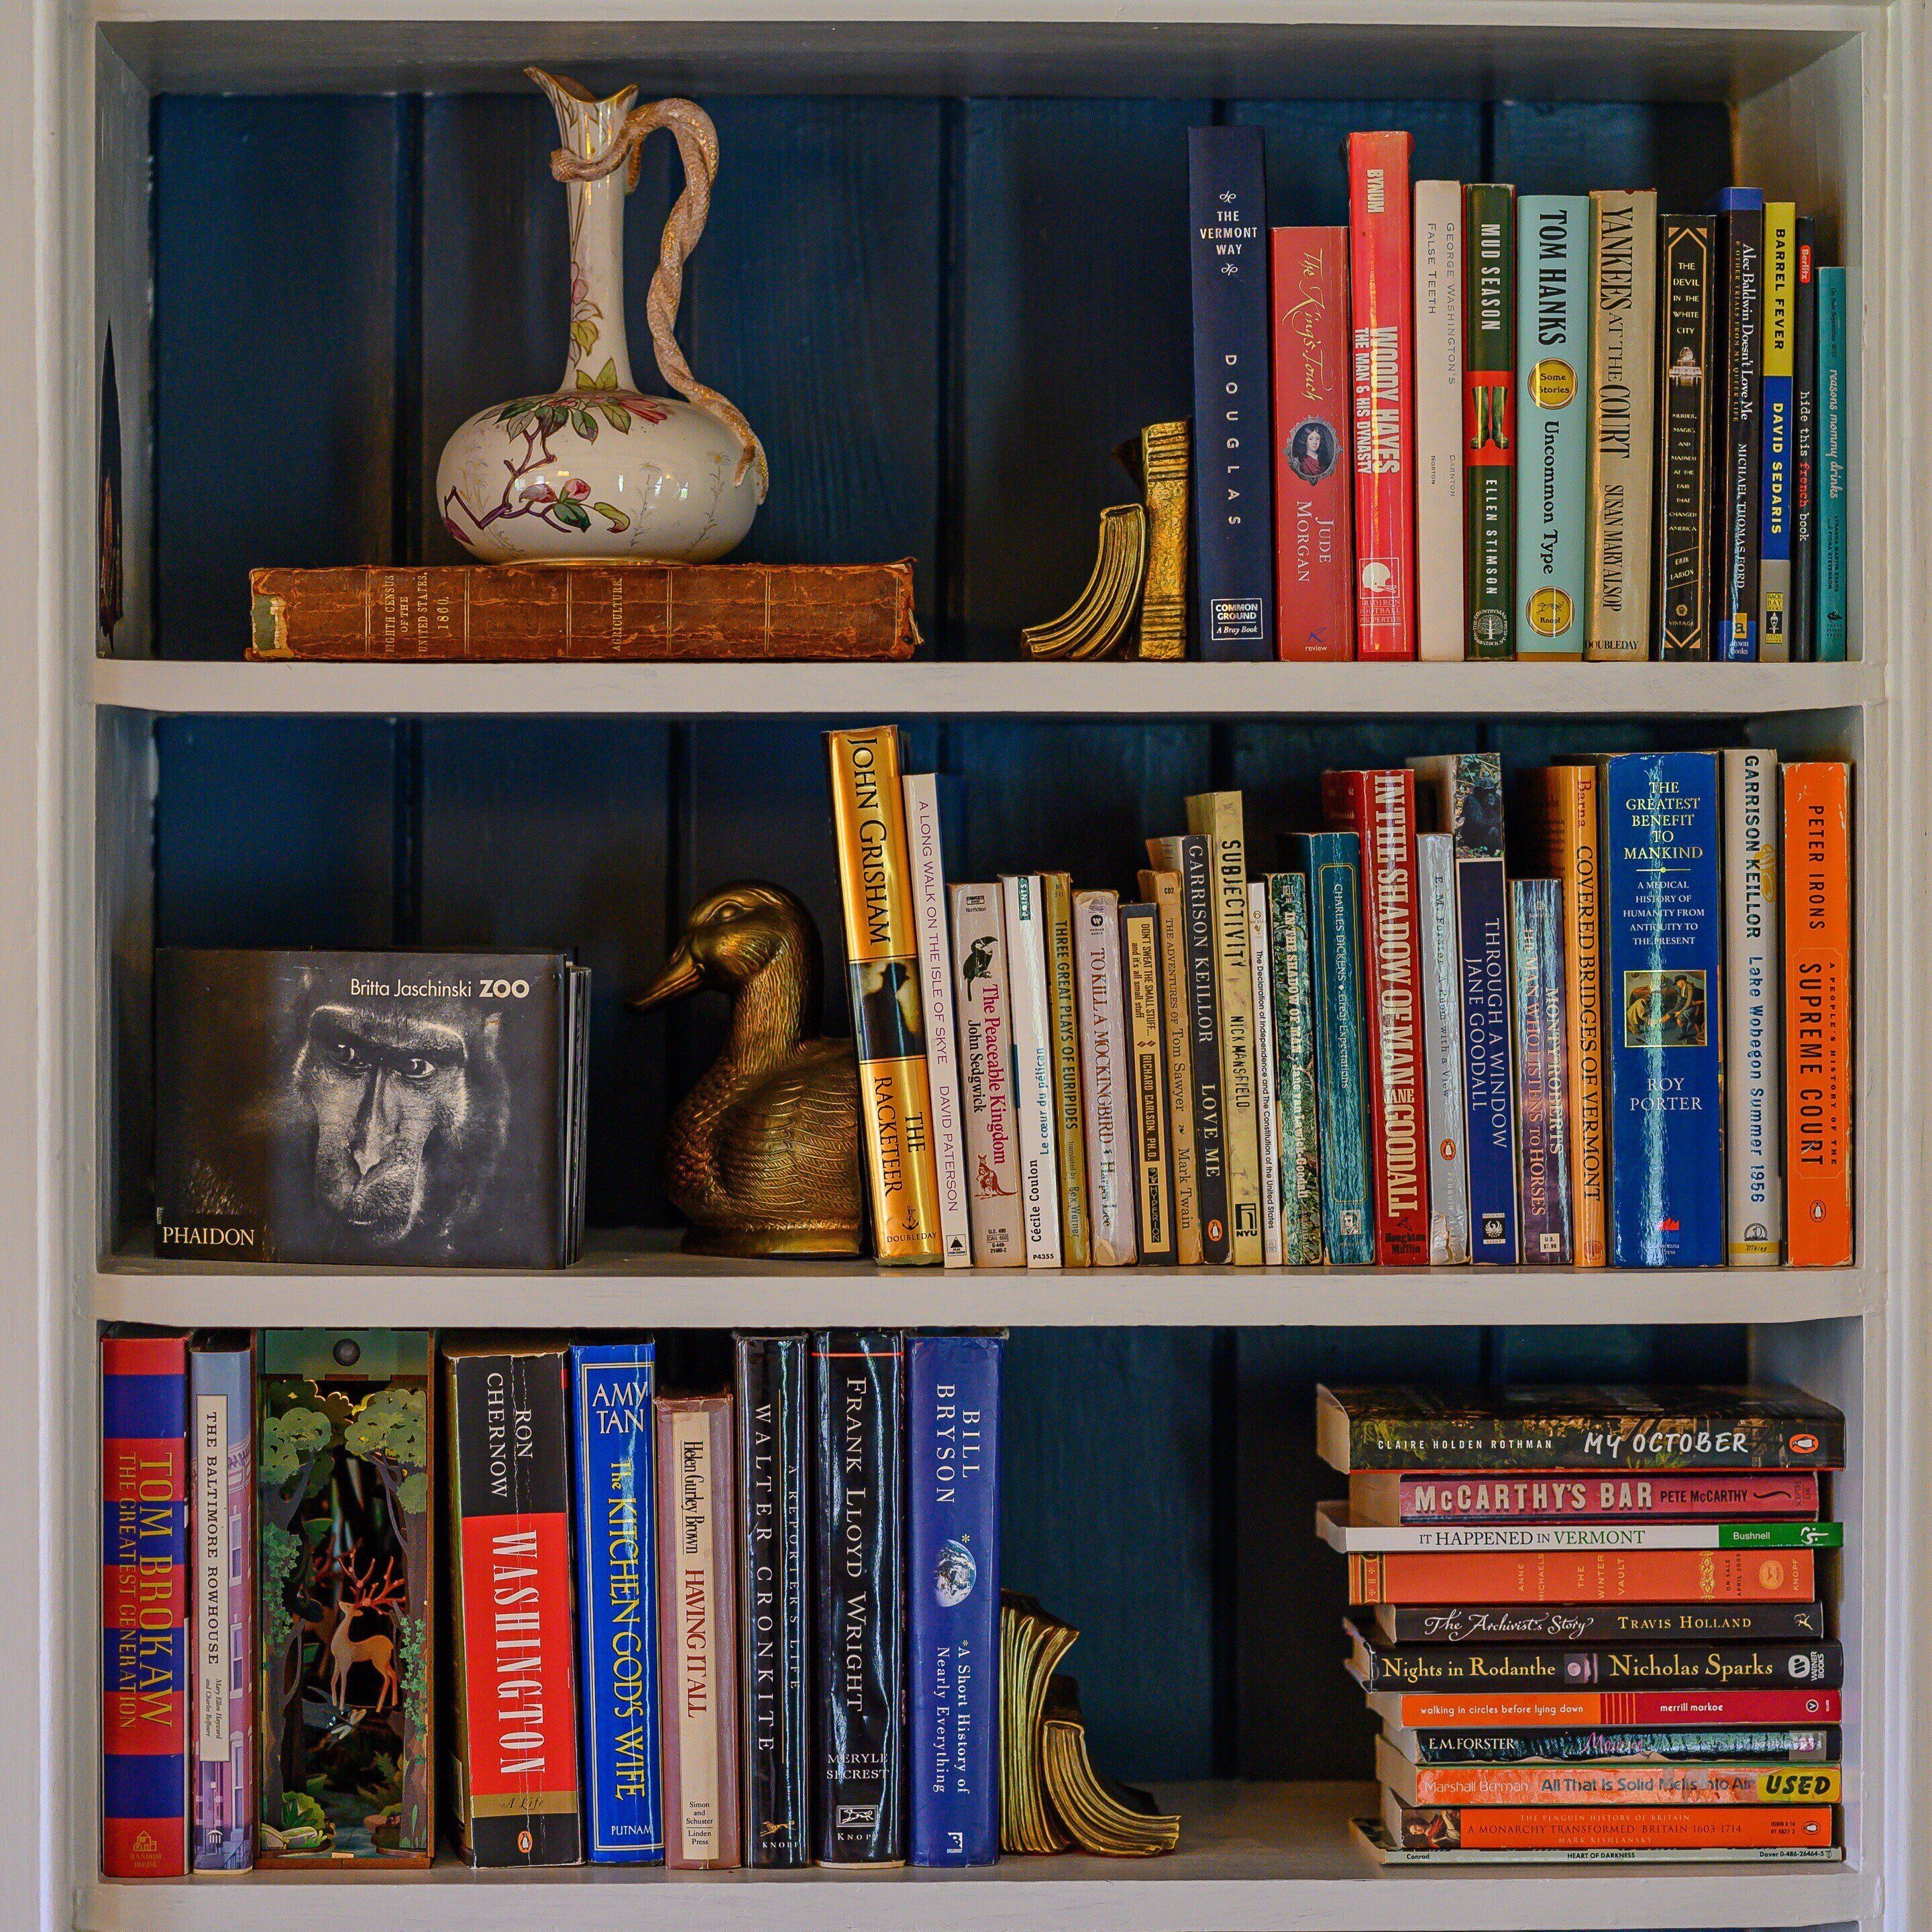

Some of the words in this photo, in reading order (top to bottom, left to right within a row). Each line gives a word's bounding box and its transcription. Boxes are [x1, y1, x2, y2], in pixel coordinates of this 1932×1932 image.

[1366, 168, 1384, 213] BYNUM
[1200, 227, 1258, 239] VERMONT
[1217, 211, 1242, 222] THE
[1539, 209, 1568, 262] TOM
[1216, 244, 1243, 254] WAY
[1299, 248, 1322, 276] The
[1428, 223, 1436, 266] FALSE
[1446, 222, 1456, 278] GEORGE
[1481, 223, 1500, 260] MUD
[1599, 206, 1634, 311] YANKEES
[1741, 243, 1756, 270] Alec
[1774, 228, 1786, 292] BARREL
[1800, 248, 1810, 280] Berlitz
[1283, 280, 1324, 349] King's
[1428, 270, 1438, 314] TEETH
[1481, 266, 1500, 330] SEASON
[1538, 268, 1568, 345] HANKS
[1741, 272, 1756, 322] Baldwin
[1446, 283, 1457, 385] WASHINGTON'S
[1607, 312, 1623, 337] AT
[1741, 323, 1754, 368] Doesn't
[1774, 298, 1786, 350] FEVER
[1301, 350, 1333, 400] Touch
[1368, 326, 1399, 404] WOODY
[1607, 341, 1625, 382] THE
[1740, 370, 1752, 397] Love
[1740, 400, 1751, 420] Me
[1799, 391, 1811, 423] hide
[1829, 369, 1841, 410] reasons
[1225, 356, 1241, 525] DOUGLAS
[1372, 409, 1400, 474] HAYES
[1599, 384, 1631, 460] COURT
[1772, 402, 1784, 453] DAVID
[1799, 428, 1811, 456] this
[1825, 413, 1840, 458] mommy
[1543, 421, 1559, 523] Uncommon
[1799, 462, 1811, 507] french
[1829, 461, 1843, 498] drinks
[1485, 479, 1498, 521] ELLEN
[1770, 462, 1783, 535] SEDARIS
[1297, 500, 1315, 582] MORGAN
[1316, 517, 1334, 563] JUDE
[1799, 513, 1810, 541] book
[1485, 530, 1498, 595] STIMSON
[1540, 529, 1558, 574] Type
[418, 572, 428, 612] STATES.
[437, 596, 449, 629] 1860.
[418, 616, 428, 652] UNITED
[1215, 612, 1257, 621] GROUND
[1584, 639, 1639, 649] DOUBLEDAY
[847, 737, 879, 810] JOHN
[1648, 782, 1678, 795] THE
[1625, 797, 1701, 811] GREATEST
[1631, 814, 1695, 827] BENEFIT
[1745, 755, 1761, 852] GARRISON
[1623, 846, 1703, 860] MANKIND
[1808, 805, 1825, 862] PETER
[859, 819, 891, 946] GRISHAM
[1188, 845, 1209, 948] GARRISON
[1221, 840, 1246, 967] SUBJECTIVITY
[1575, 845, 1595, 951] COVERED
[1746, 859, 1761, 938] KEILLOR
[1809, 873, 1826, 931] IRONS
[350, 979, 389, 996] Britta
[394, 979, 472, 998] Jaschinski
[478, 979, 530, 998] ZOO
[1463, 957, 1483, 1005] JANE
[1485, 918, 1505, 1026] THROUGH
[1748, 955, 1764, 998] Lake
[982, 984, 1000, 1013] The
[1195, 957, 1213, 1043] KEILLOR
[1576, 954, 1597, 1053] BRIDGES
[1799, 963, 1823, 1075] SUPREME
[967, 1019, 984, 1051] John
[1230, 1016, 1247, 1043] NICK
[1489, 1032, 1505, 1047] A
[1746, 1004, 1764, 1080] Wobegon
[985, 1017, 1006, 1092] Peaceable
[1232, 1044, 1250, 1108] MANSFIELD
[1469, 1012, 1487, 1111] GOODALL
[1579, 1056, 1598, 1084] OF
[969, 1053, 987, 1113] Sedgwick
[1489, 1051, 1507, 1148] WINDOW
[904, 1111, 926, 1153] THE
[987, 1095, 1008, 1165] Kingdom
[1201, 1084, 1218, 1138] LOVE
[1750, 1087, 1766, 1156] Summer
[1800, 1089, 1823, 1165] COURT
[873, 1076, 902, 1197] RACKETEER
[1581, 1085, 1601, 1201] VERMONT
[1029, 1160, 1040, 1203] Coulon
[1178, 1148, 1191, 1183] Mark
[1204, 1148, 1220, 1177] ME
[1750, 1165, 1765, 1202] 1956
[1032, 1206, 1041, 1242] Cécile
[1179, 1187, 1193, 1230] Twain
[162, 1226, 255, 1246] PHAIDON
[592, 1382, 647, 1408] AMY
[206, 1411, 217, 1450] THE
[488, 1373, 508, 1497] CHERNOW
[515, 1409, 533, 1458] RON
[596, 1409, 645, 1434] TAN
[845, 1377, 867, 1473] FRANK
[936, 1384, 955, 1503] BRYSON
[683, 1440, 704, 1472] Helen
[962, 1410, 979, 1479] BILL
[1378, 1440, 1426, 1450] CLAIRE
[1433, 1439, 1484, 1450] HOLDEN
[1491, 1439, 1552, 1449] ROTHMAN
[1584, 1433, 1621, 1458] MY
[1631, 1432, 1749, 1455] OCTOBER
[119, 1452, 136, 1491] THE
[609, 1460, 633, 1490] The
[681, 1473, 704, 1514] Gurley
[755, 1403, 773, 1541] WALTER
[139, 1452, 172, 1538] TOM
[207, 1455, 219, 1558] BALTIMORE
[1414, 1483, 1587, 1513] McCARTHY'S
[1601, 1482, 1653, 1509] BAR
[119, 1497, 136, 1598] GREATEST
[684, 1515, 704, 1554] Brown
[846, 1487, 866, 1578] LLOYD
[1419, 1534, 1432, 1544] IT
[1434, 1530, 1534, 1546] HAPPENED
[1536, 1532, 1550, 1543] IN
[1553, 1529, 1646, 1544] VERMONT
[1733, 1531, 1771, 1541] Bushnell
[608, 1497, 641, 1623] KITCHEN
[207, 1566, 219, 1664] ROWHOUSE
[685, 1569, 706, 1650] HAVING
[1617, 1616, 1672, 1630] TRAVIS
[1680, 1615, 1752, 1629] HOLLAND
[140, 1554, 172, 1729] BROKAW
[492, 1529, 545, 1774] WASHINGTON
[756, 1566, 775, 1751] CRONKITE
[846, 1591, 868, 1712] WRIGHT
[119, 1604, 137, 1729] GENERATION
[612, 1631, 643, 1718] GOD'S
[686, 1655, 706, 1679] IT
[1381, 1658, 1443, 1683] Nights
[1447, 1660, 1465, 1676] in
[1469, 1656, 1556, 1676] Rodanthe
[1609, 1654, 1699, 1677] Nicholas
[1705, 1654, 1773, 1681] Sparks
[686, 1680, 706, 1718] ALL
[614, 1725, 645, 1801] WIFE
[1766, 1775, 1831, 1796] USED
[610, 1825, 653, 1835] PUTNAM
[1759, 1850, 1779, 1858] Dover
